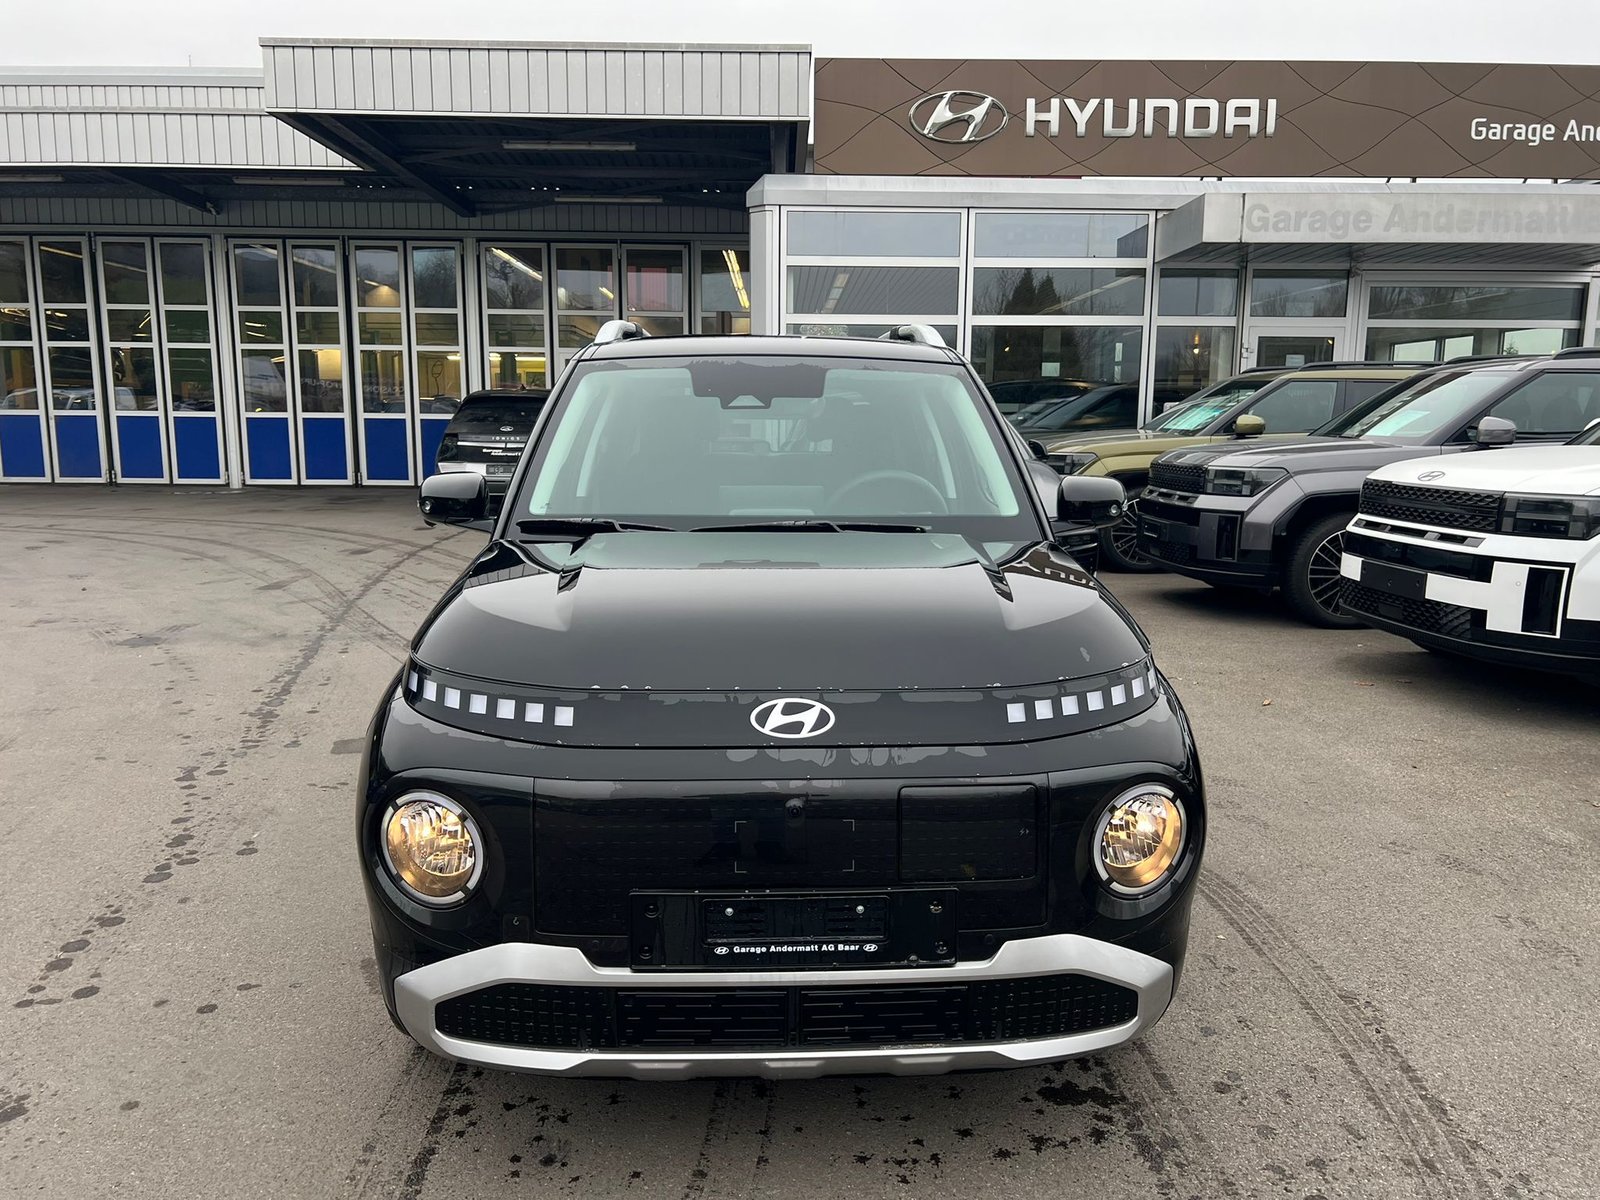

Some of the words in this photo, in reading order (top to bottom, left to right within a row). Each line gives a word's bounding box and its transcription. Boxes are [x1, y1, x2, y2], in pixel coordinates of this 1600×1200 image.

[1025, 98, 1277, 138] HYUNDAI
[1470, 118, 1556, 147] Garage
[1245, 203, 1373, 240] Garage
[1383, 202, 1570, 235] Andermatt
[733, 945, 767, 955] Garage
[769, 944, 819, 953] Andermatt
[821, 944, 835, 952] AG
[838, 943, 860, 951] Baar
